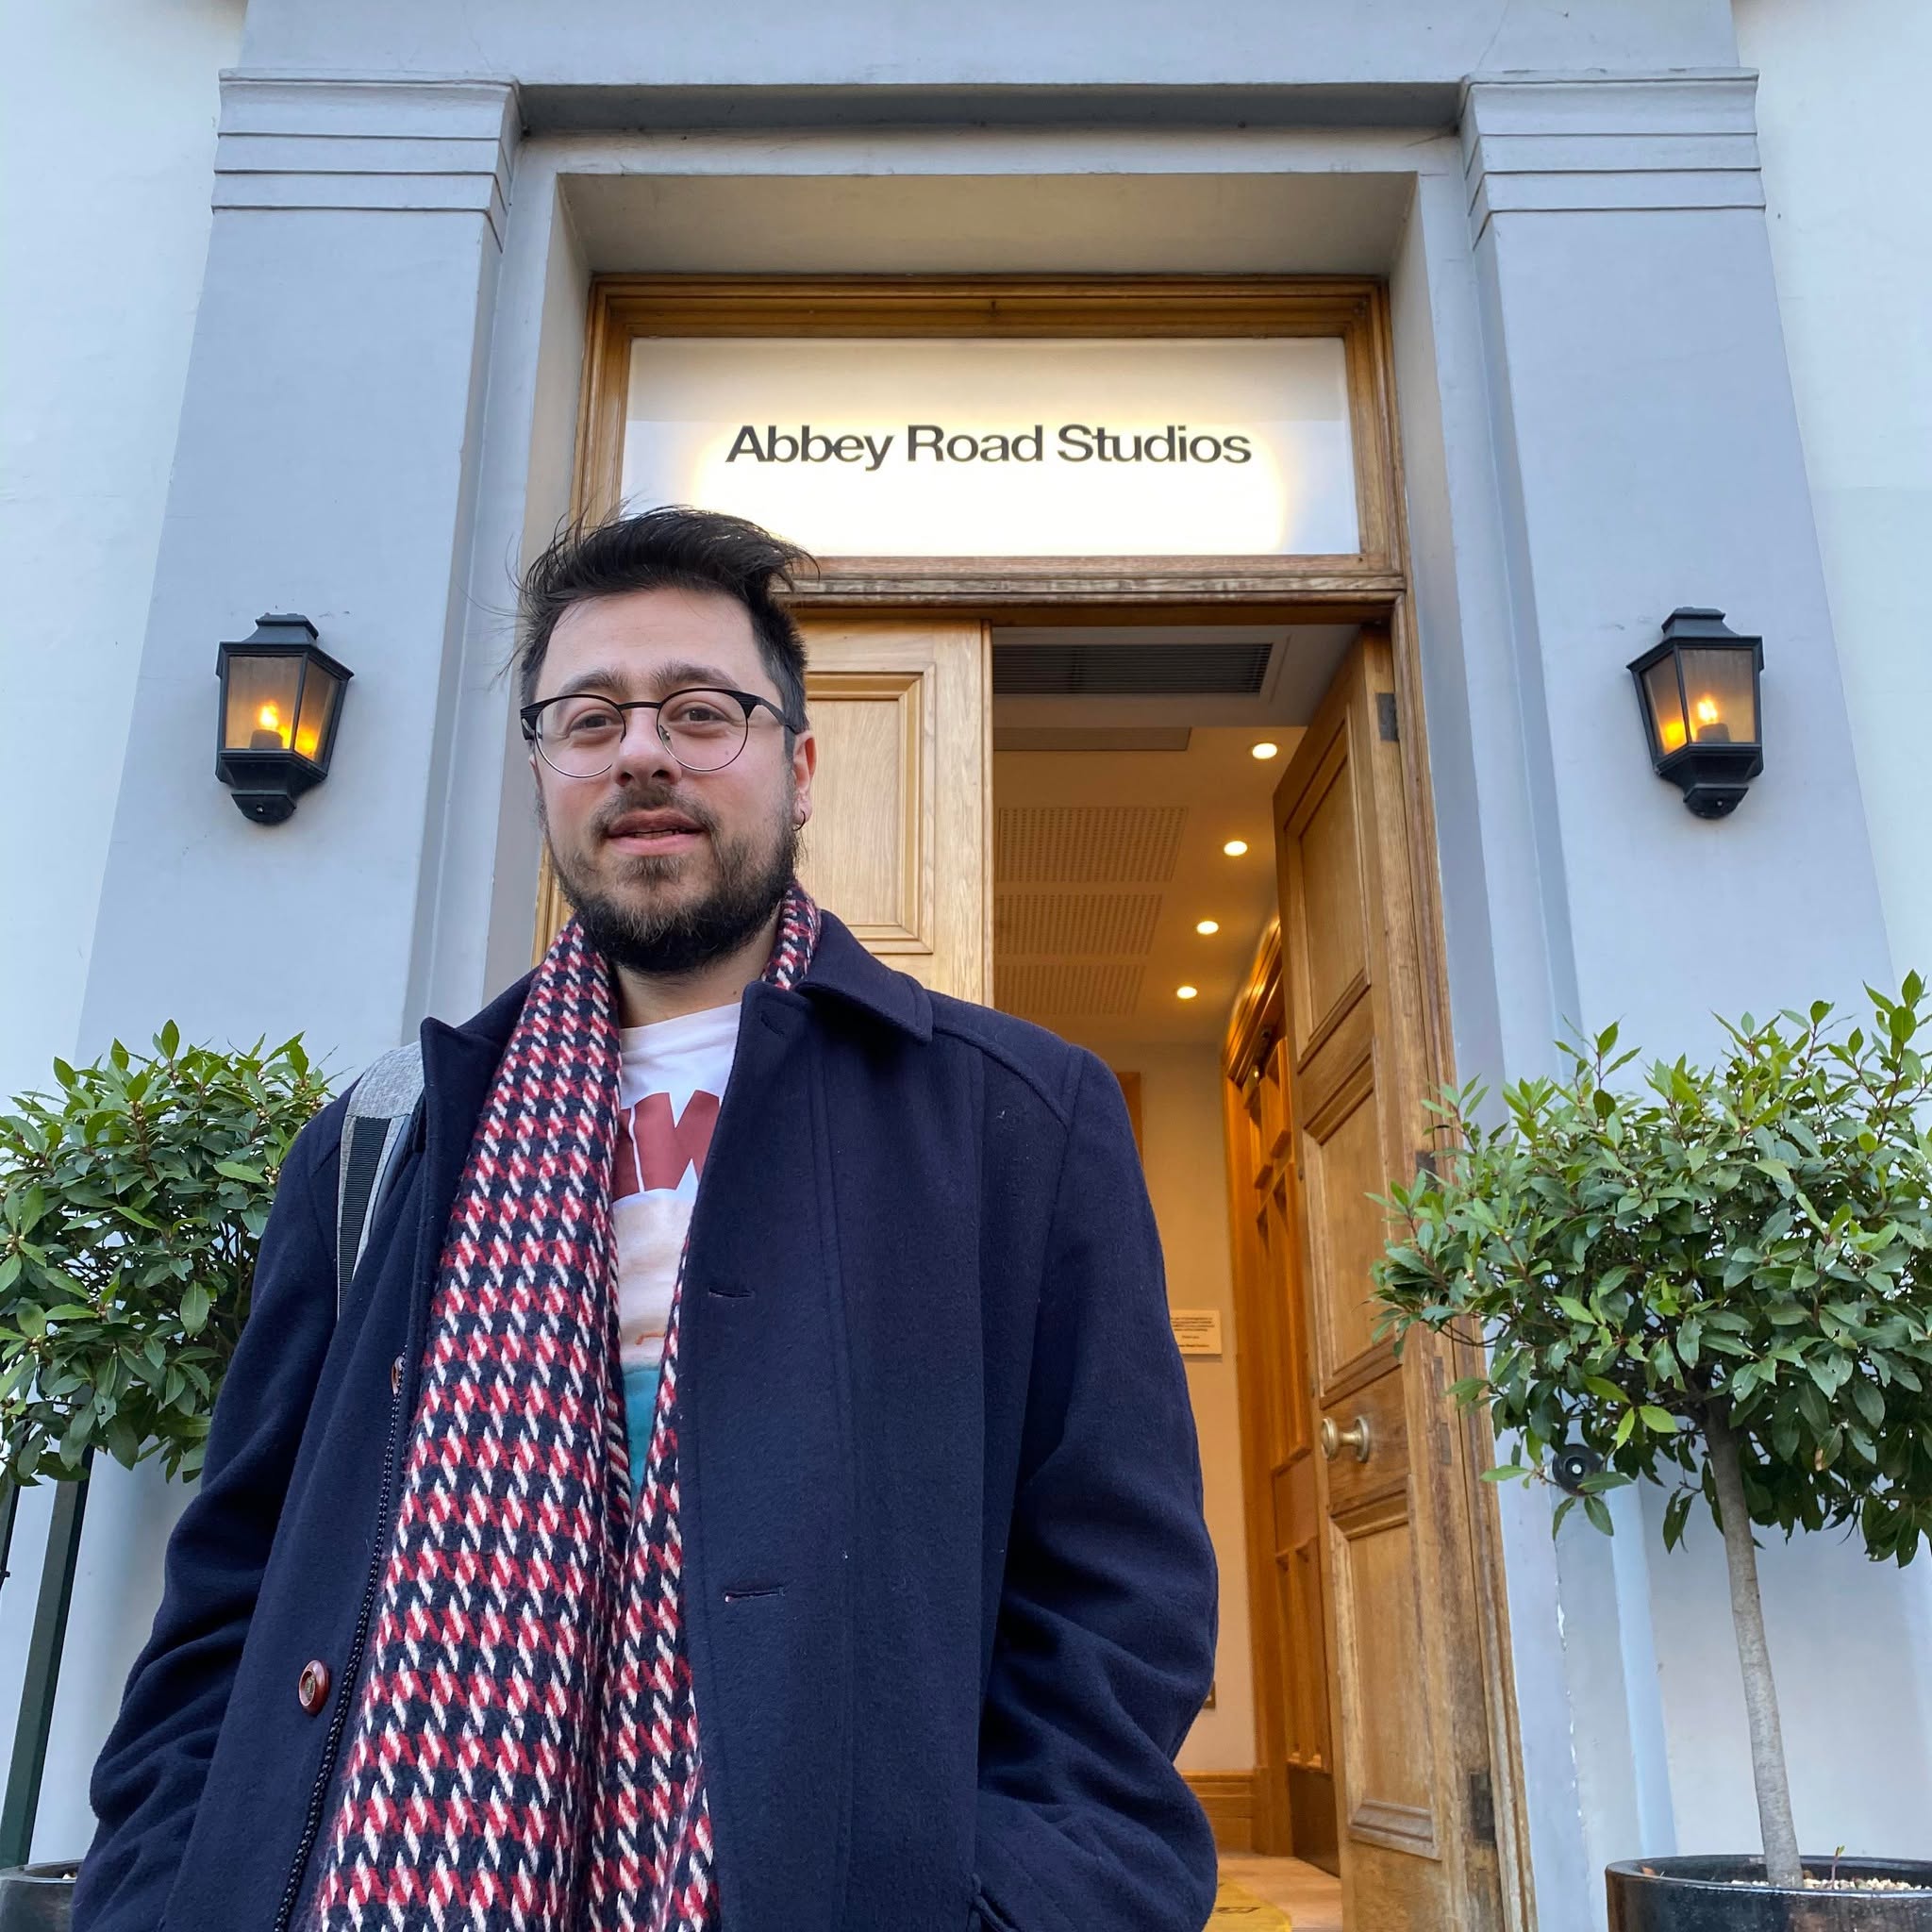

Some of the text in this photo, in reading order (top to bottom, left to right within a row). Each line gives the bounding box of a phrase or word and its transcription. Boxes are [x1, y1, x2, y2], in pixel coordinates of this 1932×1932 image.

[725, 424, 1252, 471] Abbey Road Studios
